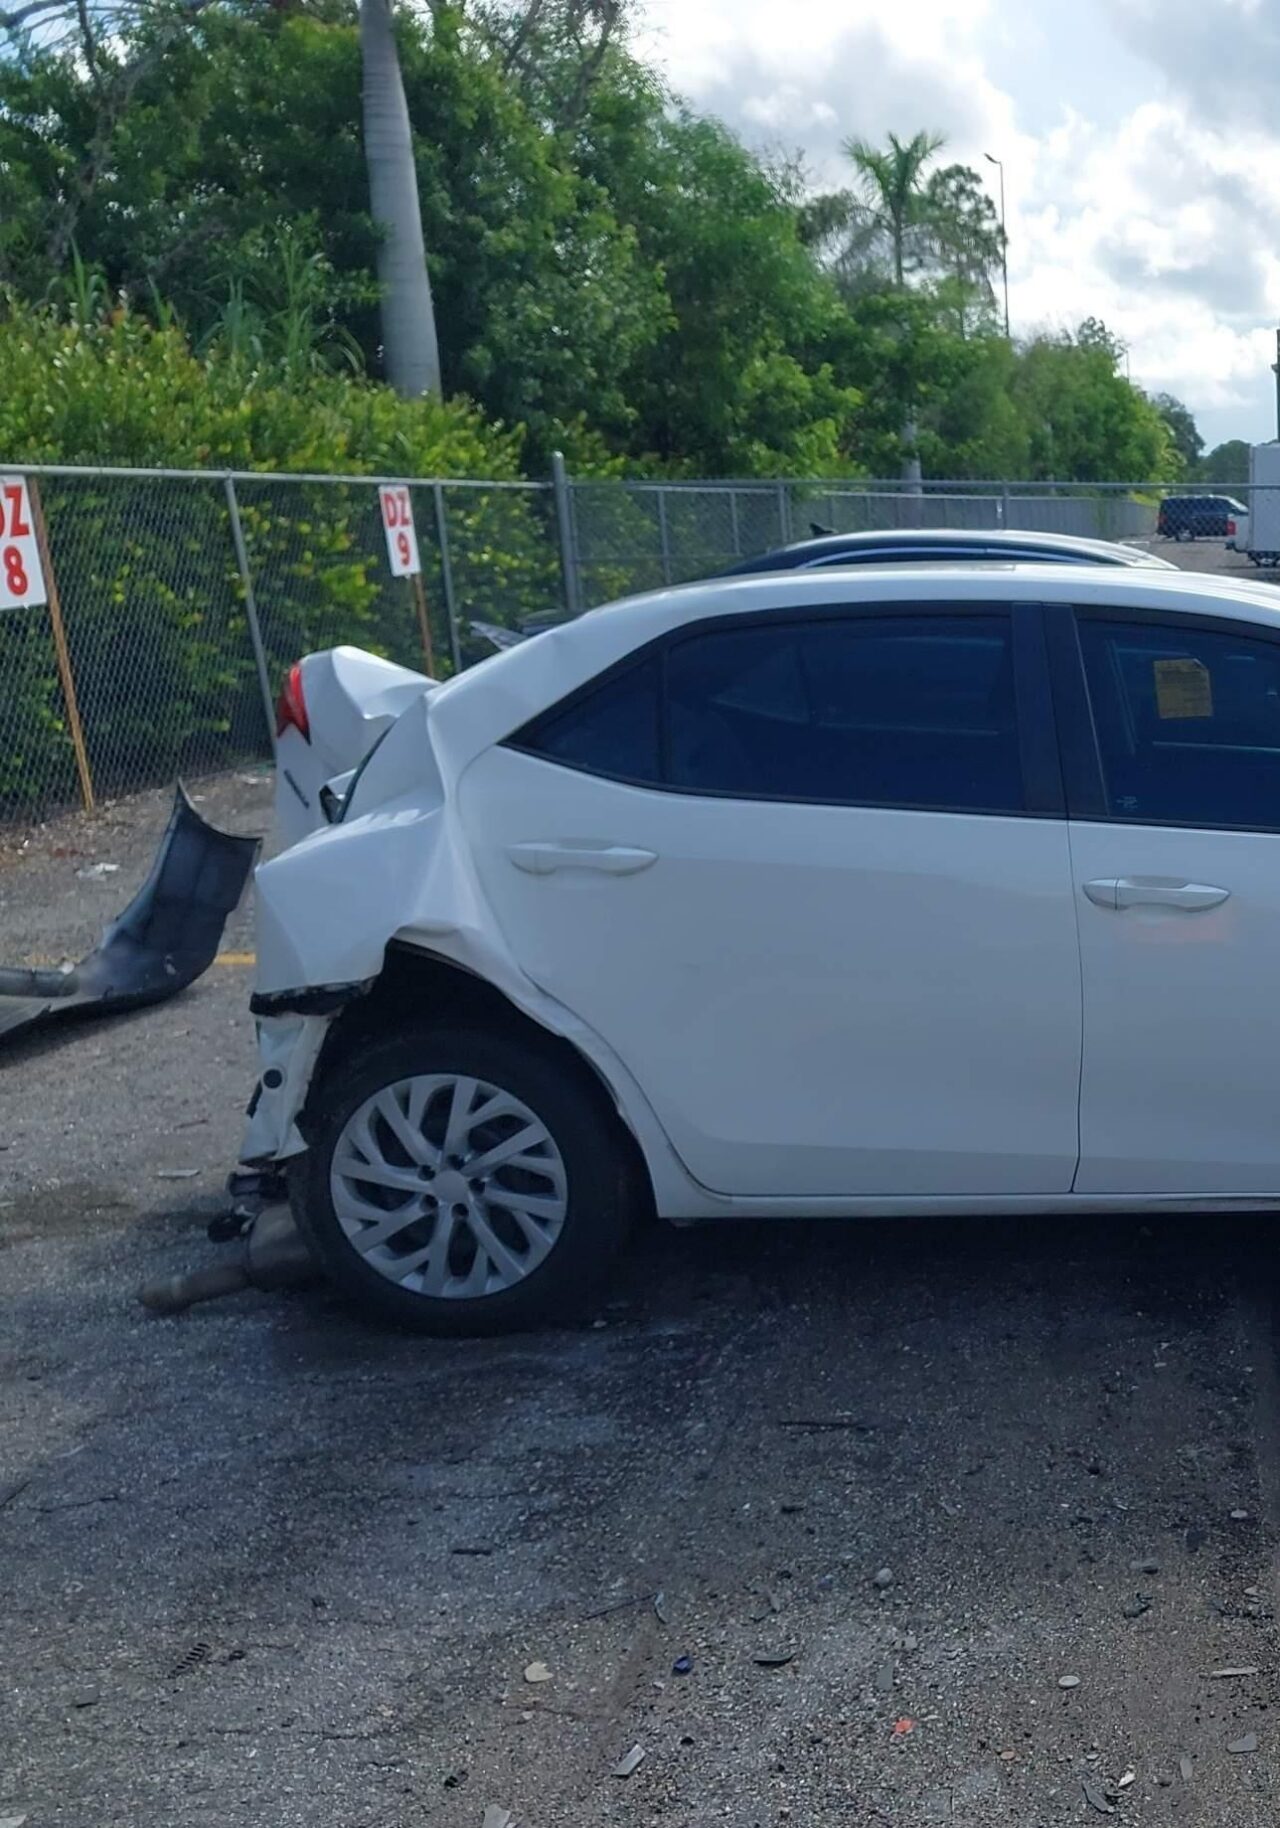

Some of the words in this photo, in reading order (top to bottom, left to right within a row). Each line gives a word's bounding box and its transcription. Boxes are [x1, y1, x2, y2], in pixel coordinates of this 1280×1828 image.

[0, 485, 30, 537] Z
[383, 491, 411, 528] DZ
[3, 545, 28, 596] 8
[397, 531, 411, 566] 9
